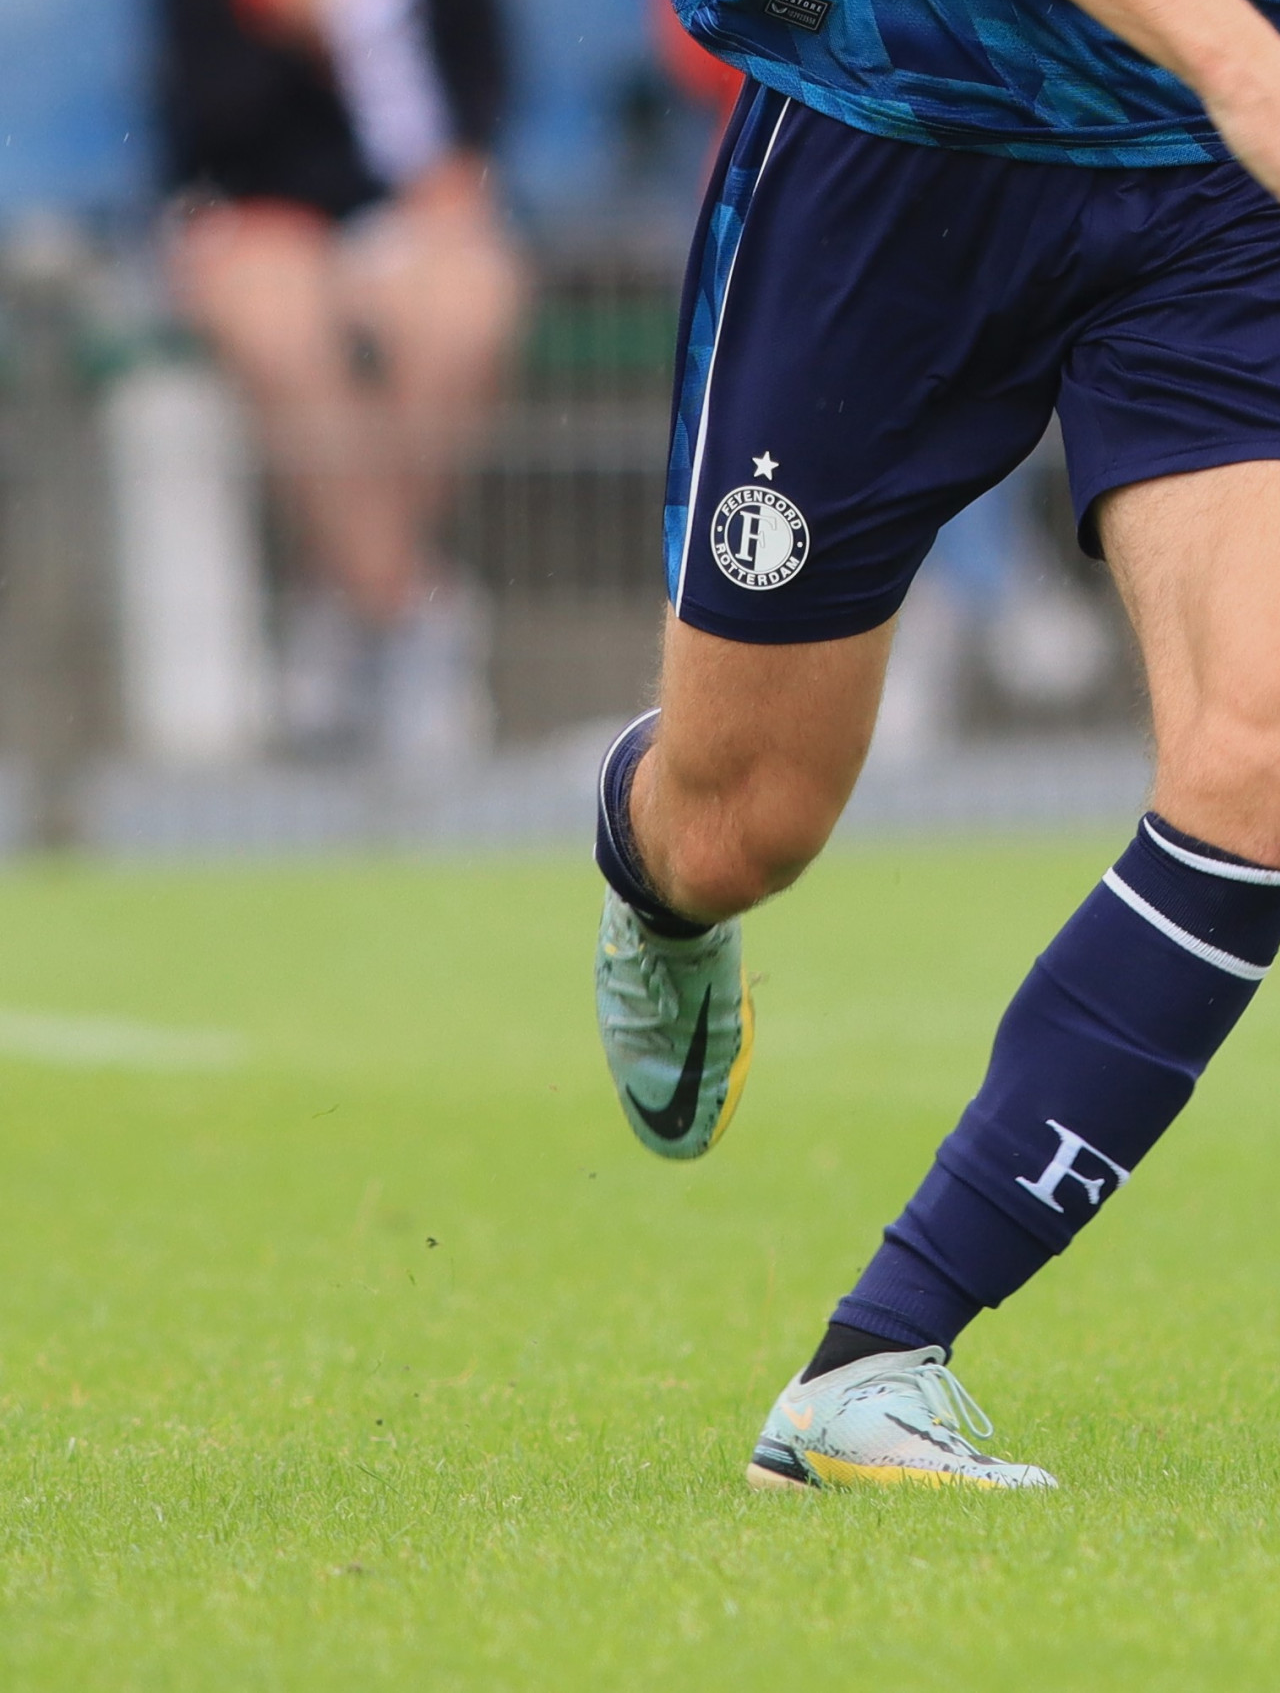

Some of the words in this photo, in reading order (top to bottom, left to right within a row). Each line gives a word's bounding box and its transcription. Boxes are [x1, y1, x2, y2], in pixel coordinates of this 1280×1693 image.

[721, 490, 803, 530] FEYENOORD
[716, 542, 800, 586] ROTTERDAM
[1015, 1118, 1131, 1214] F
